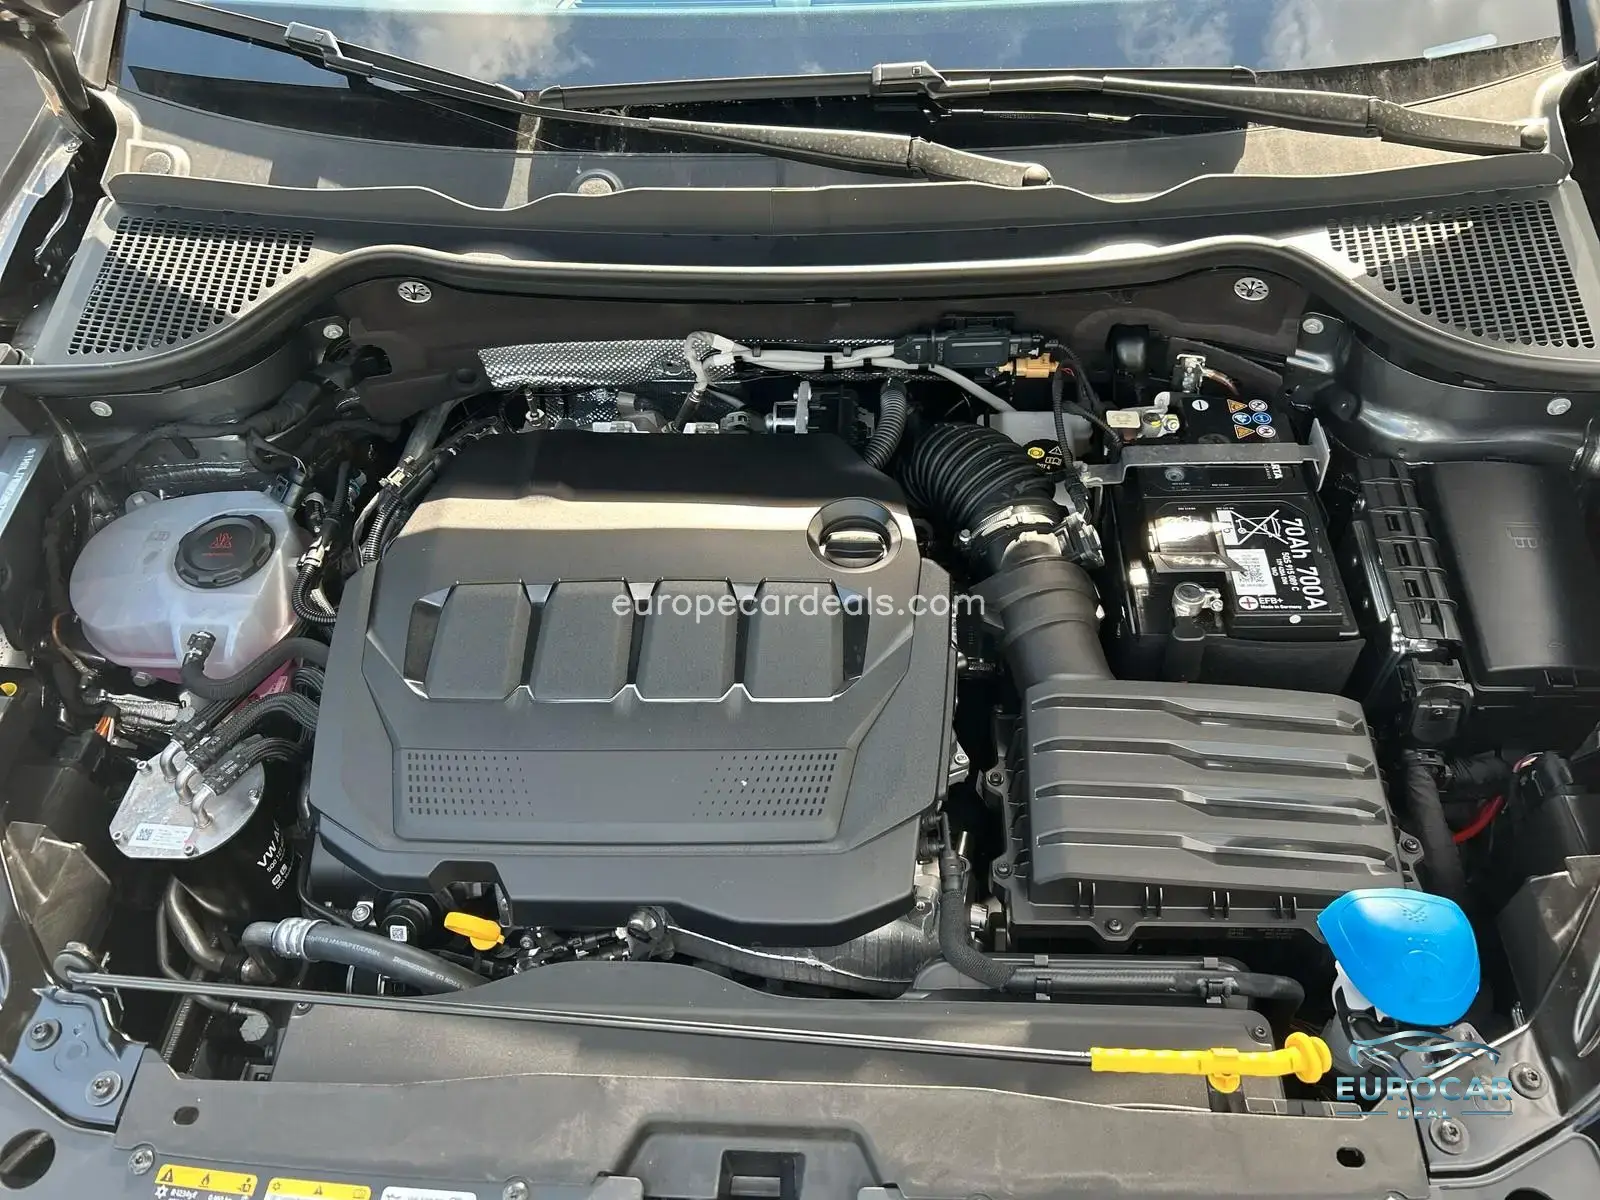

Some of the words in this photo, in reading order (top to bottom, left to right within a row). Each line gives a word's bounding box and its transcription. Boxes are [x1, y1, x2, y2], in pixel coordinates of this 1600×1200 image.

[1271, 463, 1283, 479] RTA
[1282, 518, 1312, 559] 70Ah
[1259, 597, 1284, 605] EFB+
[1296, 566, 1328, 610] 700A
[257, 840, 277, 867] VW
